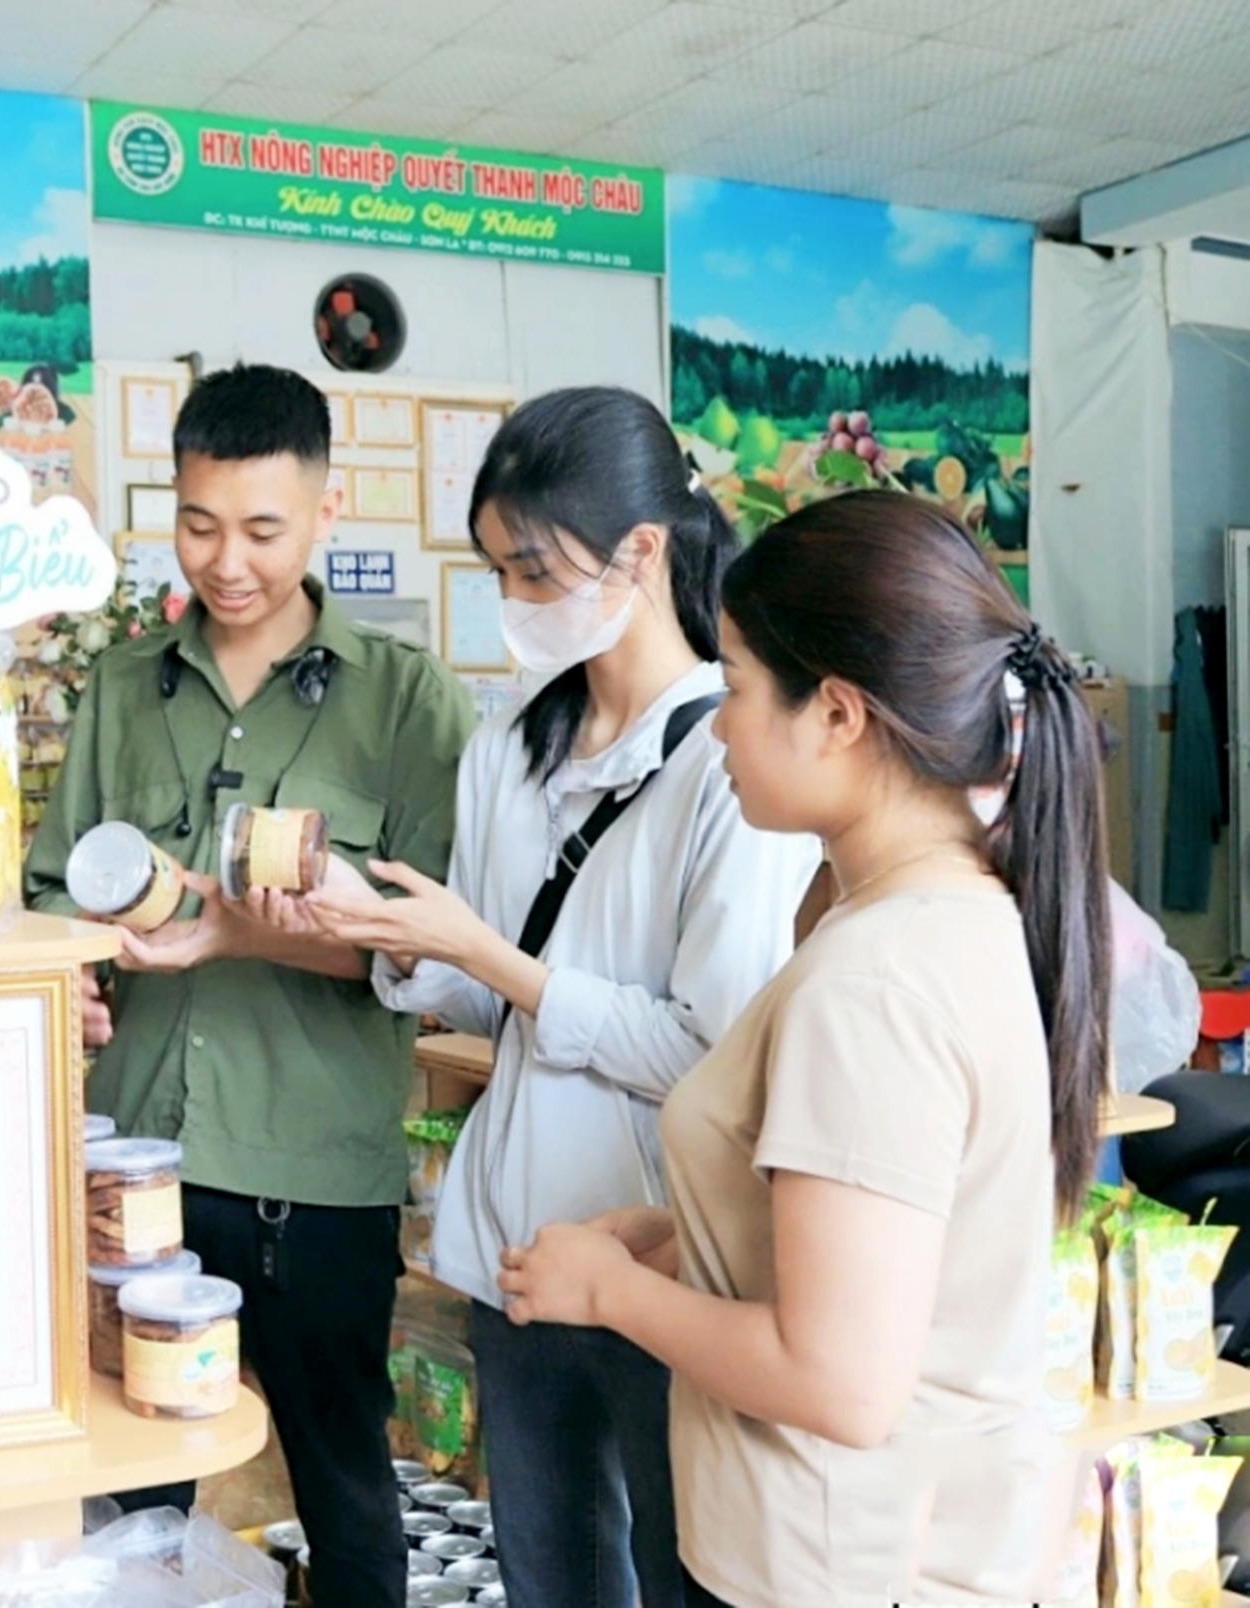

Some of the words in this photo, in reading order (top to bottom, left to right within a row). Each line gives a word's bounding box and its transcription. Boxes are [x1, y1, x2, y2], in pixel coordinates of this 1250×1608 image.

[200, 130, 243, 165] HTX
[250, 131, 312, 176] NÔNG
[318, 142, 397, 191] NGHIỆP
[404, 149, 466, 194] QUYẾT
[472, 164, 537, 201] THANH
[544, 166, 586, 213] MỘC
[591, 173, 642, 213] CHÂU
[278, 184, 343, 217] Kính
[351, 190, 415, 225] Chào
[421, 202, 475, 236] Quý
[480, 207, 558, 240] Khách
[445, 238, 460, 250] LA
